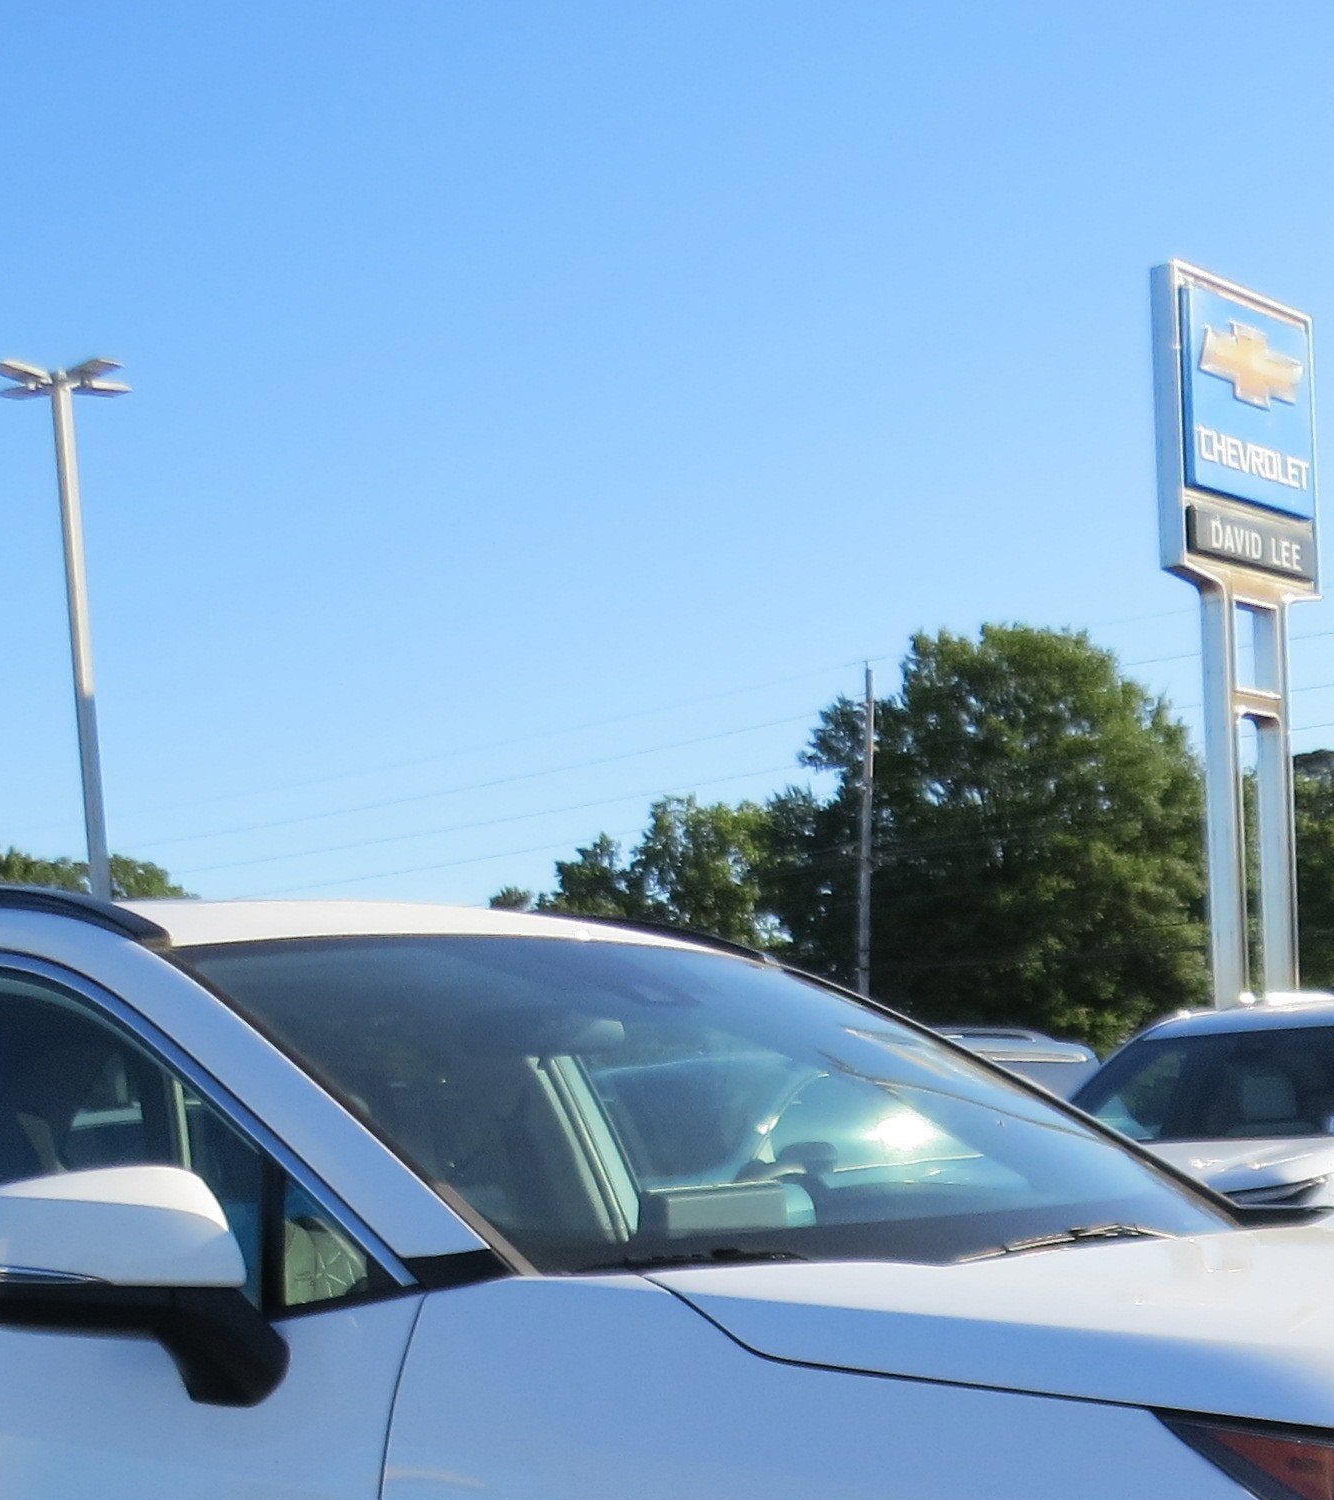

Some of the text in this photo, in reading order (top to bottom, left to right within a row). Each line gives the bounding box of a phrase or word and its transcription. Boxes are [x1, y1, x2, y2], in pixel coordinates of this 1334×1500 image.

[1196, 424, 1309, 490] CHEVROLET
[1211, 519, 1302, 571] DAVID LEE
